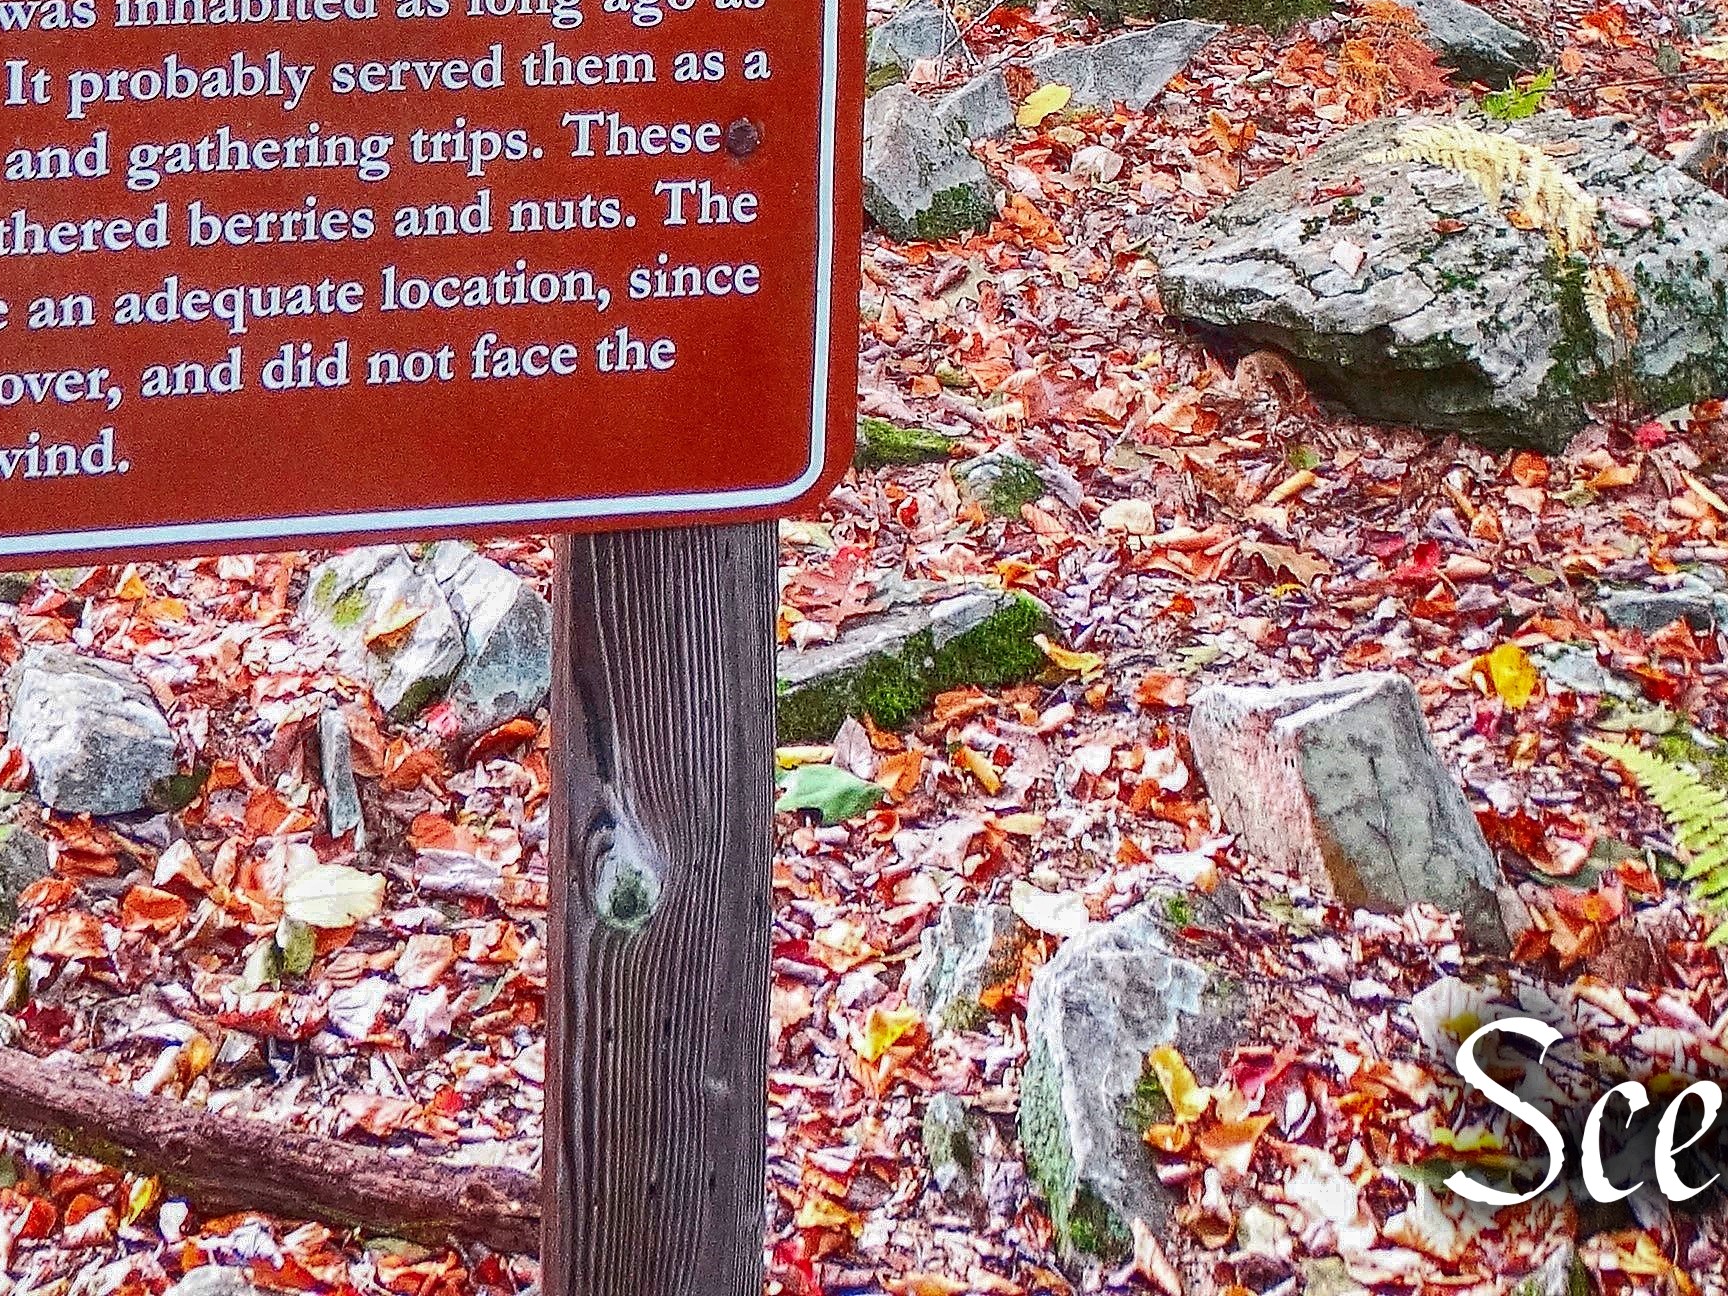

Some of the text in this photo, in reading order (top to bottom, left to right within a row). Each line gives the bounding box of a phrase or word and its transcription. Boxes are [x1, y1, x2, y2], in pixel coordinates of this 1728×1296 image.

[3, 57, 52, 106] It
[64, 50, 316, 120] probably
[332, 43, 506, 94] served
[520, 41, 657, 87] them
[674, 51, 725, 82] as
[744, 50, 772, 80] a
[4, 130, 111, 181] and
[124, 122, 394, 191] gathering
[409, 116, 544, 178] trips.
[561, 110, 721, 158] These
[187, 194, 375, 247] berries
[394, 188, 494, 238] and
[508, 193, 637, 232] nuts.
[654, 178, 758, 226] The
[28, 293, 97, 329] an
[114, 275, 365, 336] adequate
[380, 259, 611, 313] location,
[629, 252, 760, 299] since
[141, 345, 245, 397] and
[261, 339, 352, 390] did
[366, 345, 455, 385] not
[471, 332, 578, 380] face
[595, 325, 676, 372] the
